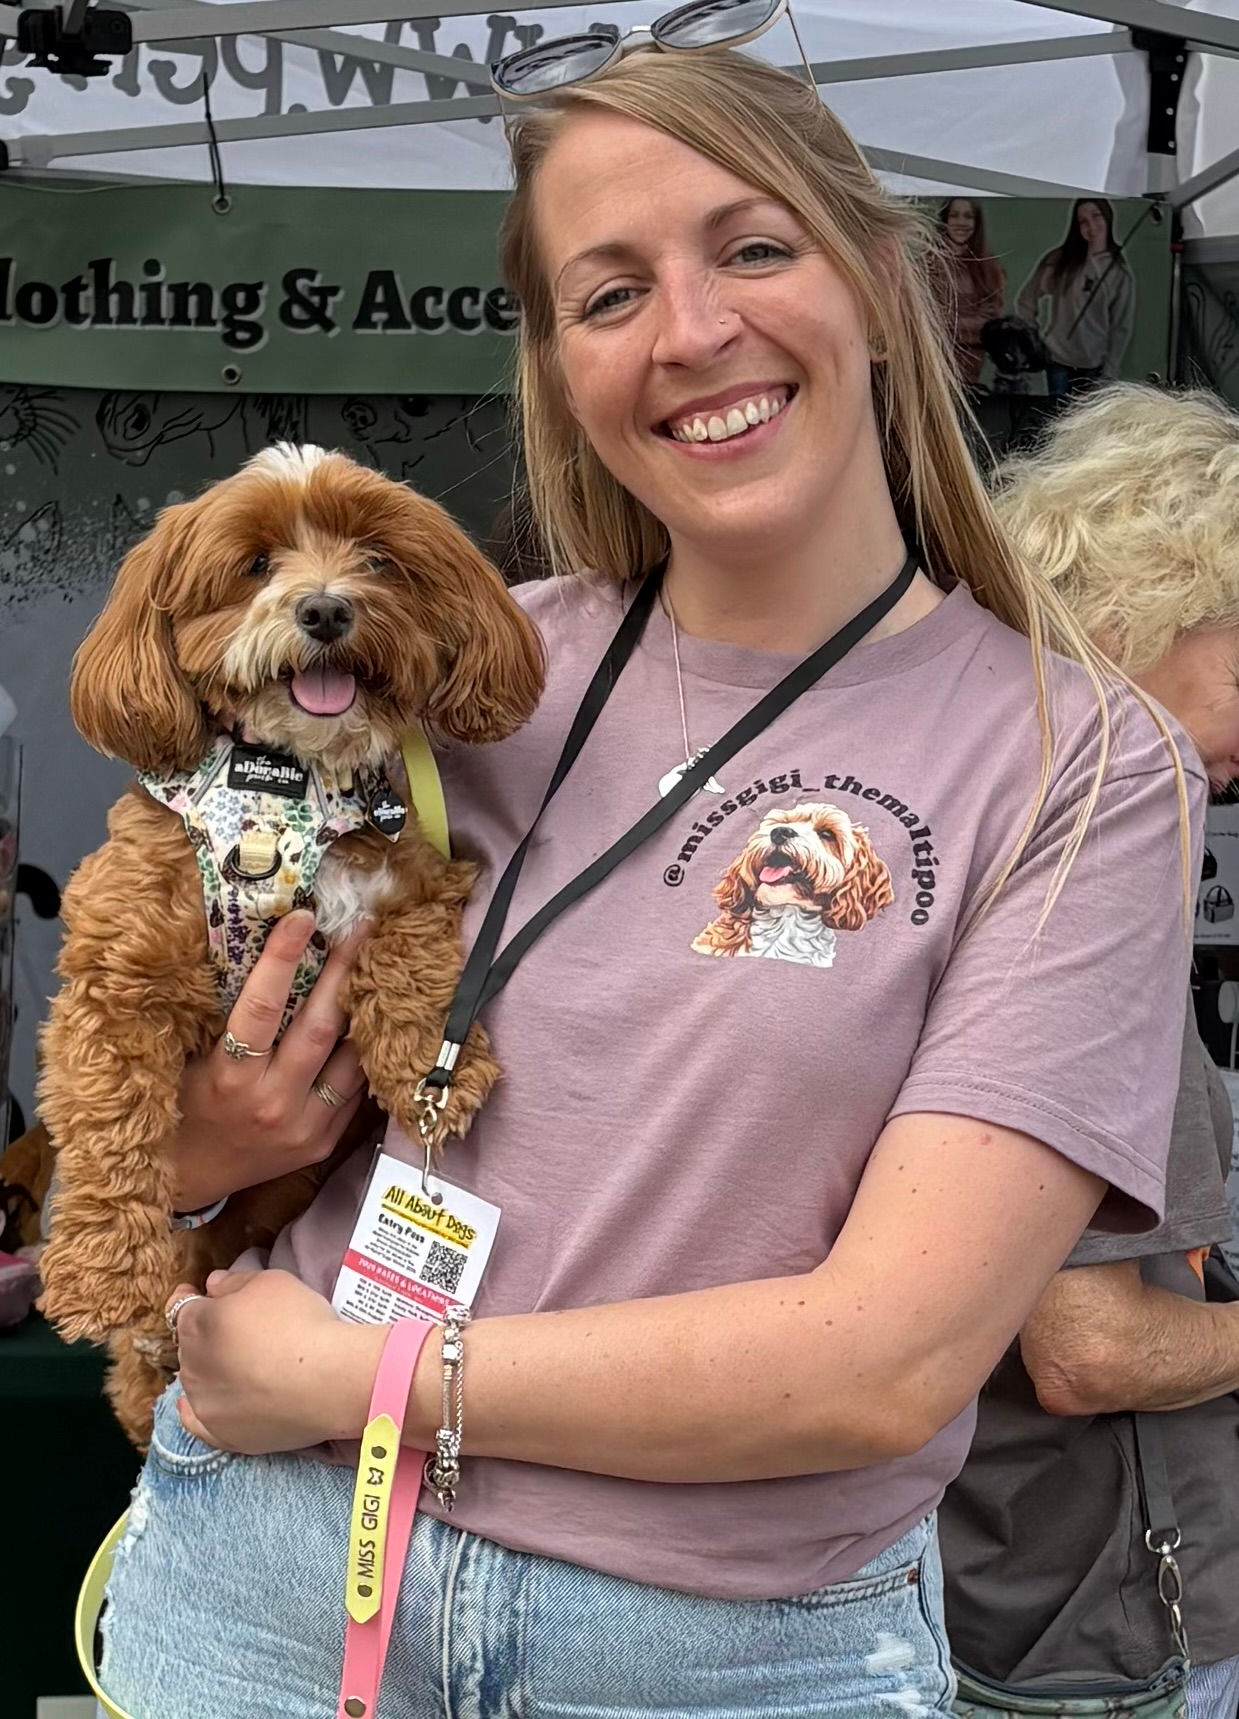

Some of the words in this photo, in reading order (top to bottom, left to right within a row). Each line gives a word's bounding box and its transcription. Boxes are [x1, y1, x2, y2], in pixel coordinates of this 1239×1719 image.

[279, 267, 341, 337] &
[663, 769, 940, 926] @missgigi_themaltipoo
[378, 1213, 403, 1235] Entry
[404, 1227, 425, 1244] Pass
[384, 1185, 406, 1206] All
[406, 1198, 446, 1227] About
[446, 1214, 476, 1241] Dogs
[361, 1494, 381, 1530] GIGI
[358, 1539, 376, 1579] MISS
